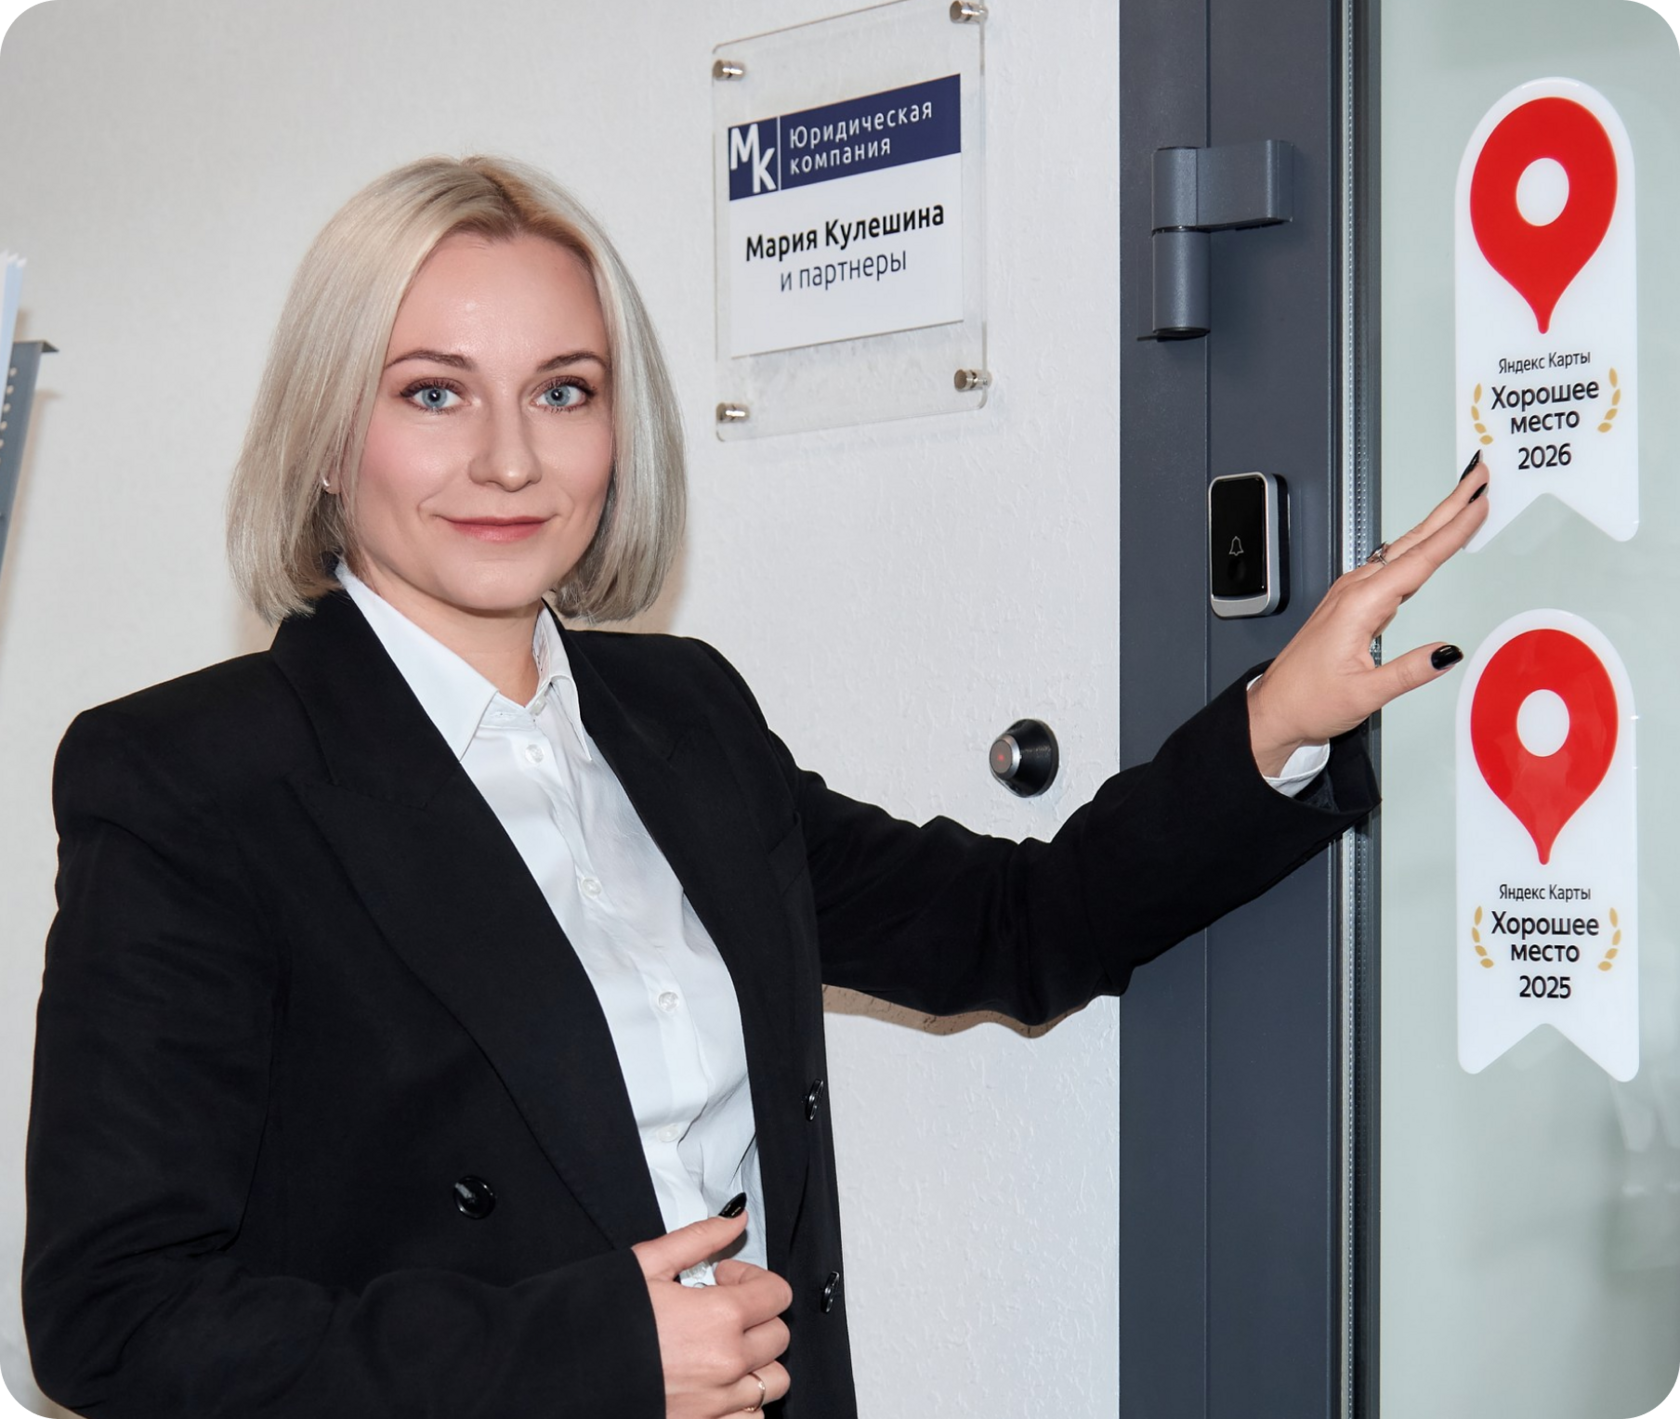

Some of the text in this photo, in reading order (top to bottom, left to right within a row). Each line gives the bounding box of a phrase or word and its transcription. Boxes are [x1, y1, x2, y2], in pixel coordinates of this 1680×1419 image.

[790, 101, 932, 149] Юридическая
[790, 138, 891, 175] компания
[746, 203, 944, 262] Мария Кулешина
[780, 250, 907, 292] и партнеры
[1499, 352, 1591, 374] Яндекс Карты
[1491, 381, 1599, 412] Хорошее
[1511, 411, 1580, 435] место
[1518, 443, 1572, 470] 2026
[1499, 884, 1591, 902] Яндекс Карты
[1491, 911, 1599, 940] Хорошее
[1511, 944, 1580, 962] место
[1519, 975, 1572, 999] 2025
